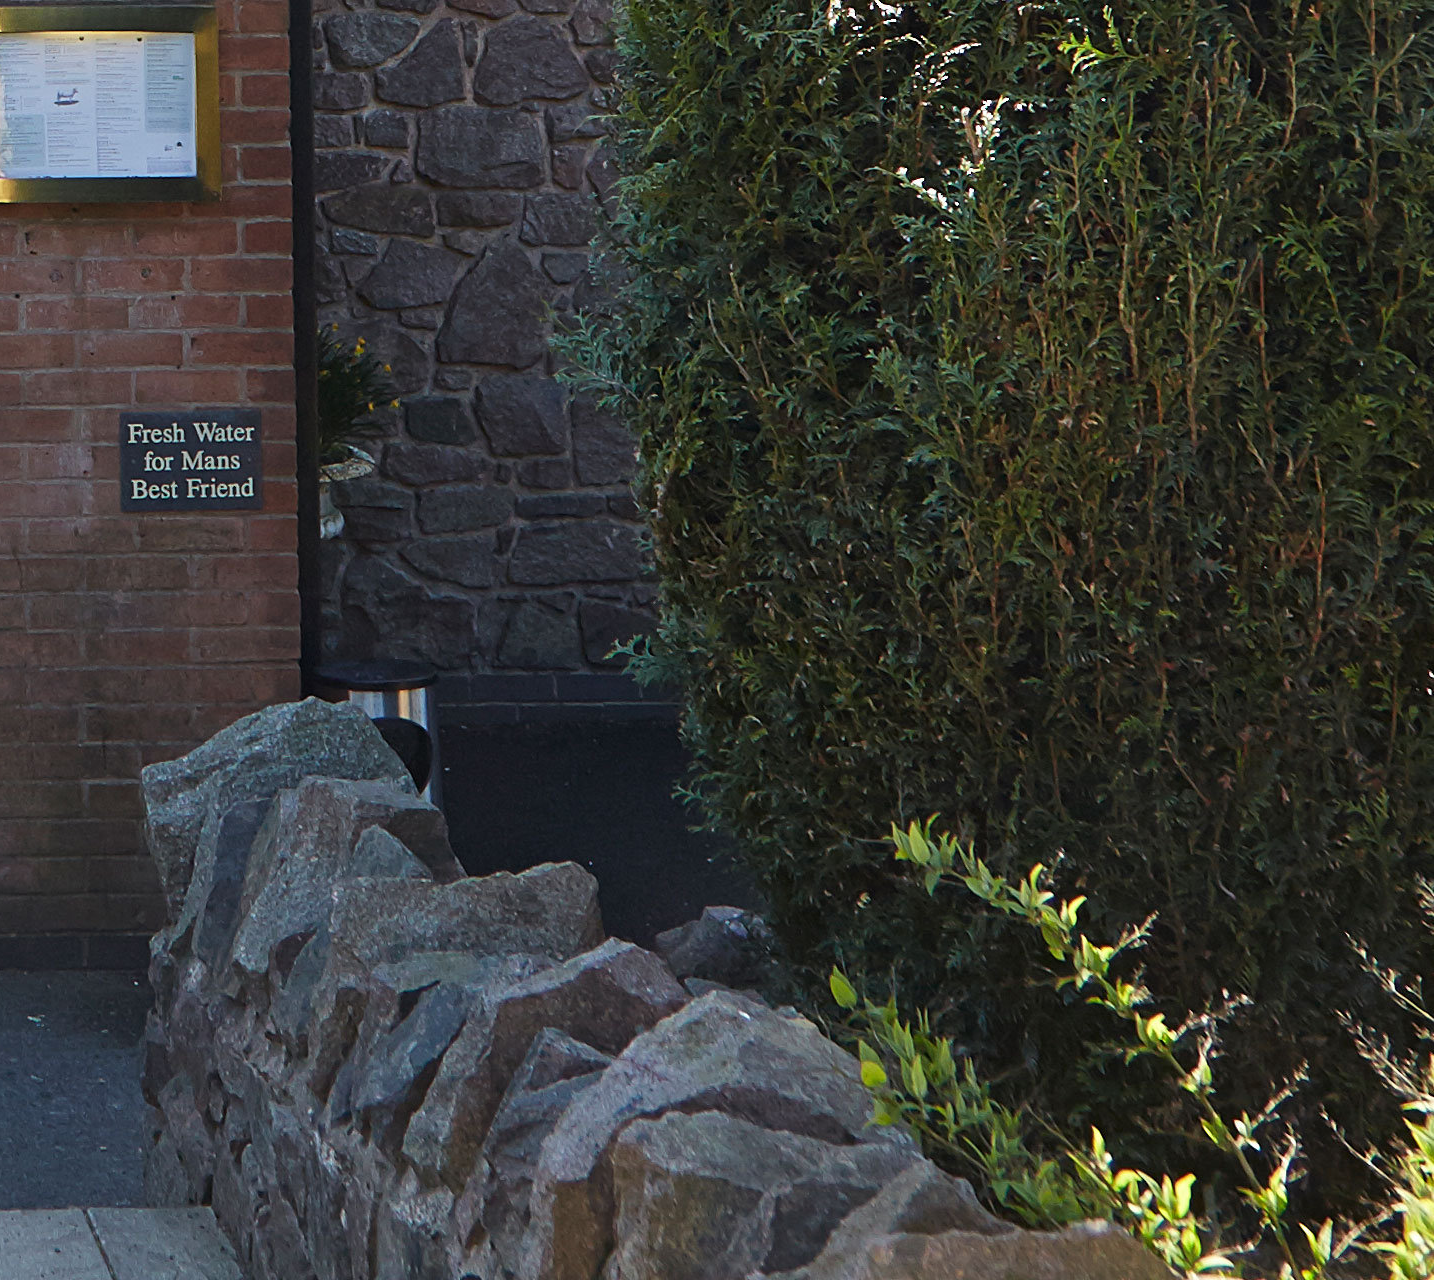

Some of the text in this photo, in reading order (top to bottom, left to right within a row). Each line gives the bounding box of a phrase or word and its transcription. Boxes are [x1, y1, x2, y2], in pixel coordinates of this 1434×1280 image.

[127, 422, 255, 443] Fresh Water
[144, 450, 241, 471] for Mans
[131, 477, 254, 500] Best Friend
